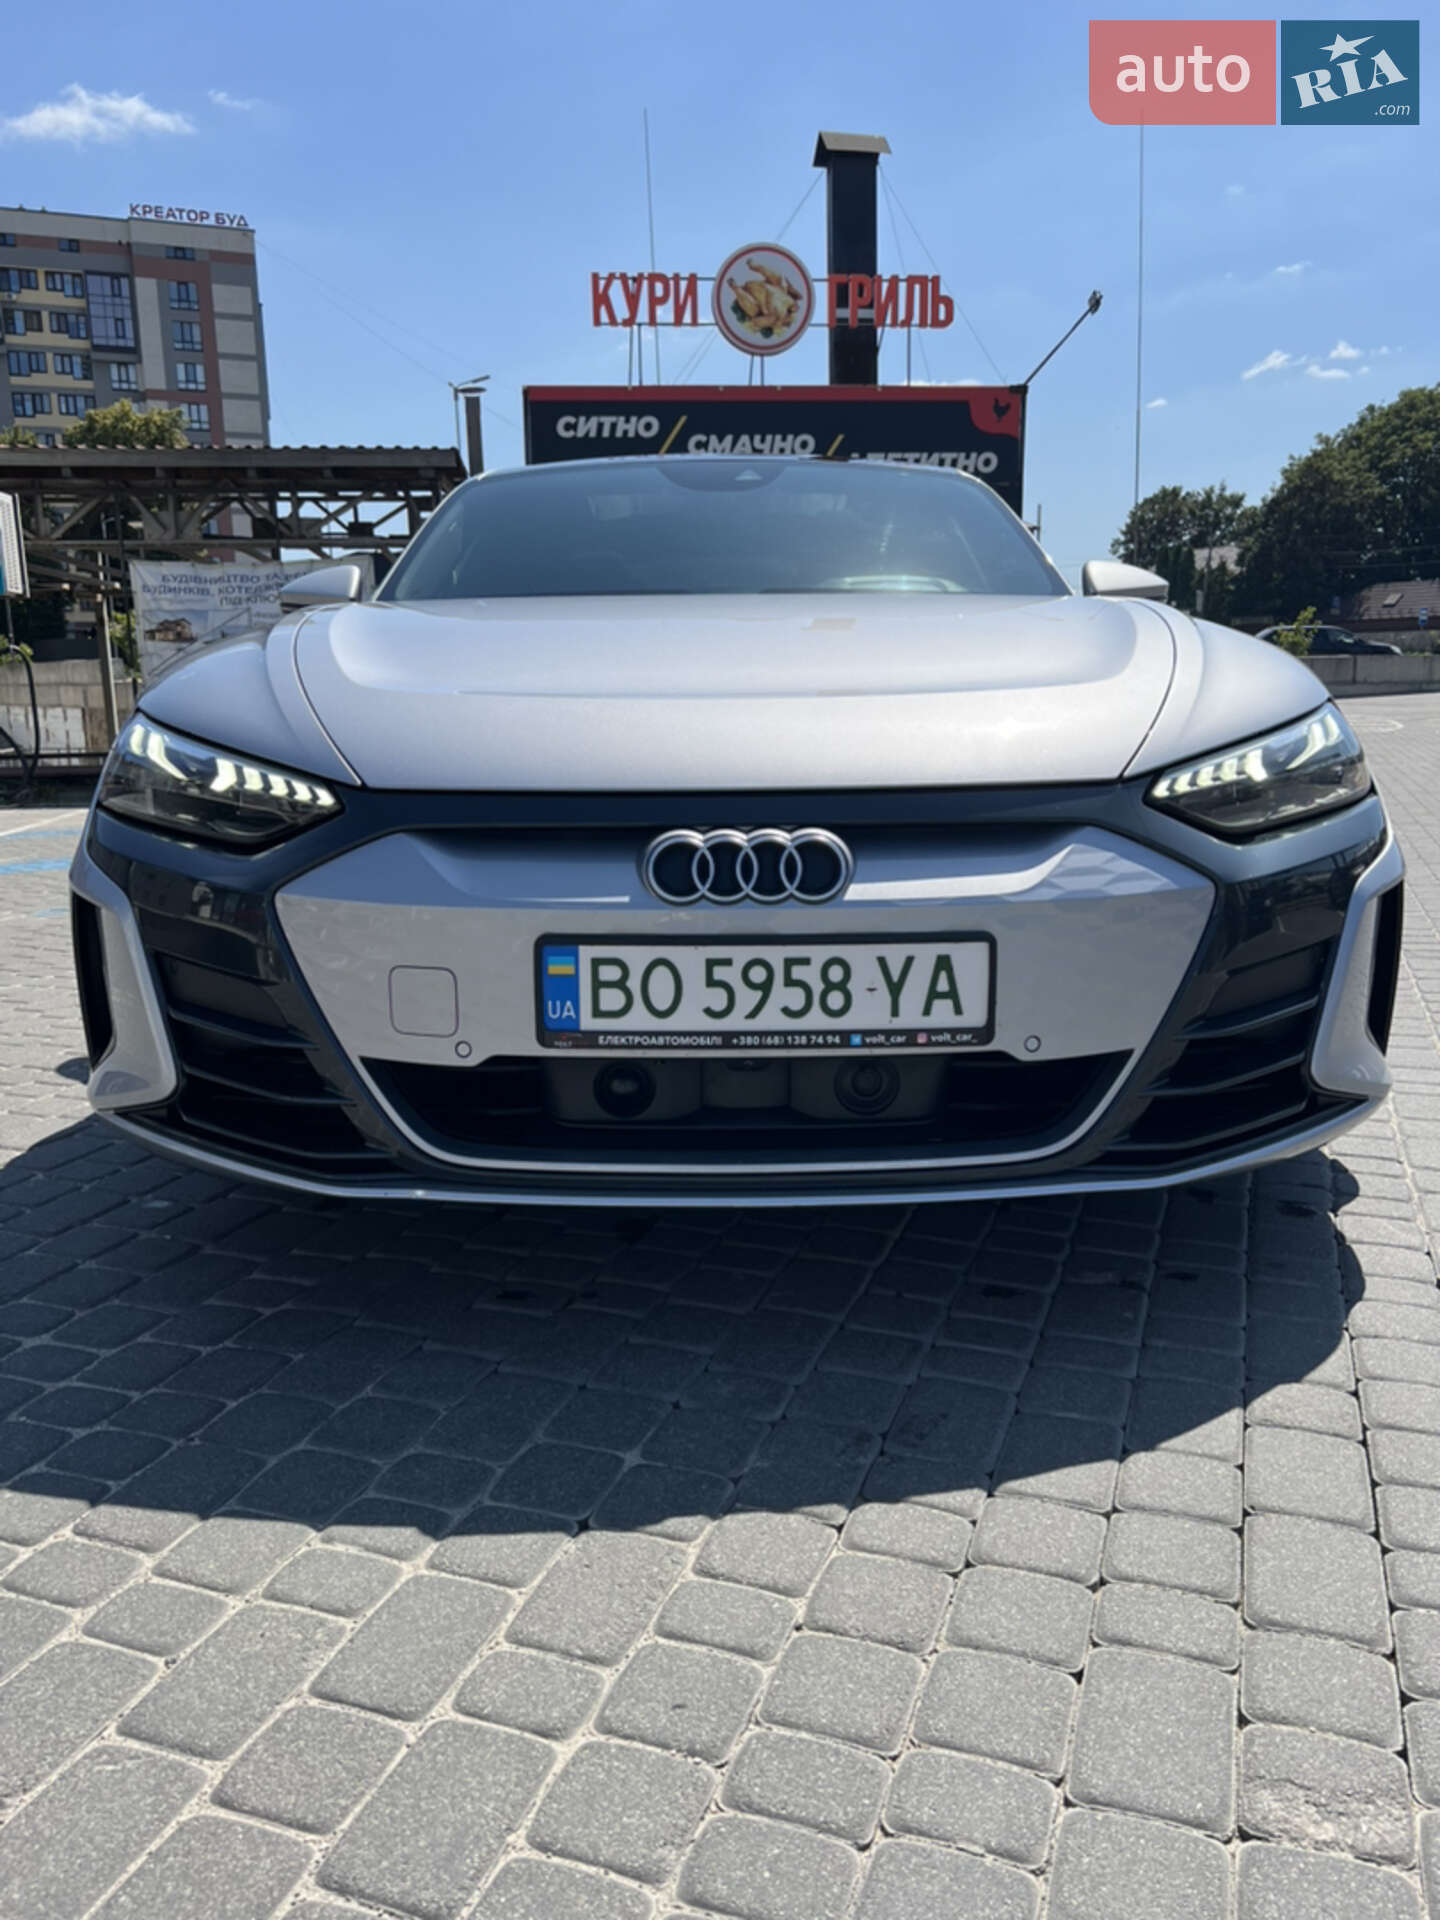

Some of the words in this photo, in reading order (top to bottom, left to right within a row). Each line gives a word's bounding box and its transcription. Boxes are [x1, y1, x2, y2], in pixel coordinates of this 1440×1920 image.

[129, 203, 210, 223] КРЕАТОР
[214, 212, 249, 227] БУД
[591, 272, 699, 328] КУРИ
[827, 274, 955, 329] ГРИЛЬ
[556, 415, 660, 438] СИТНО
[687, 433, 816, 455] СМАЧНО
[591, 957, 683, 1019] BO
[702, 956, 852, 1020] 5958
[876, 954, 963, 1018] YA
[548, 1000, 576, 1019] UA
[598, 1035, 722, 1046] ЕЛЕКТРОАВТОМОБІЛІ
[731, 1035, 759, 1046] +380
[810, 1034, 824, 1045] 74
[826, 1034, 841, 1045] 94
